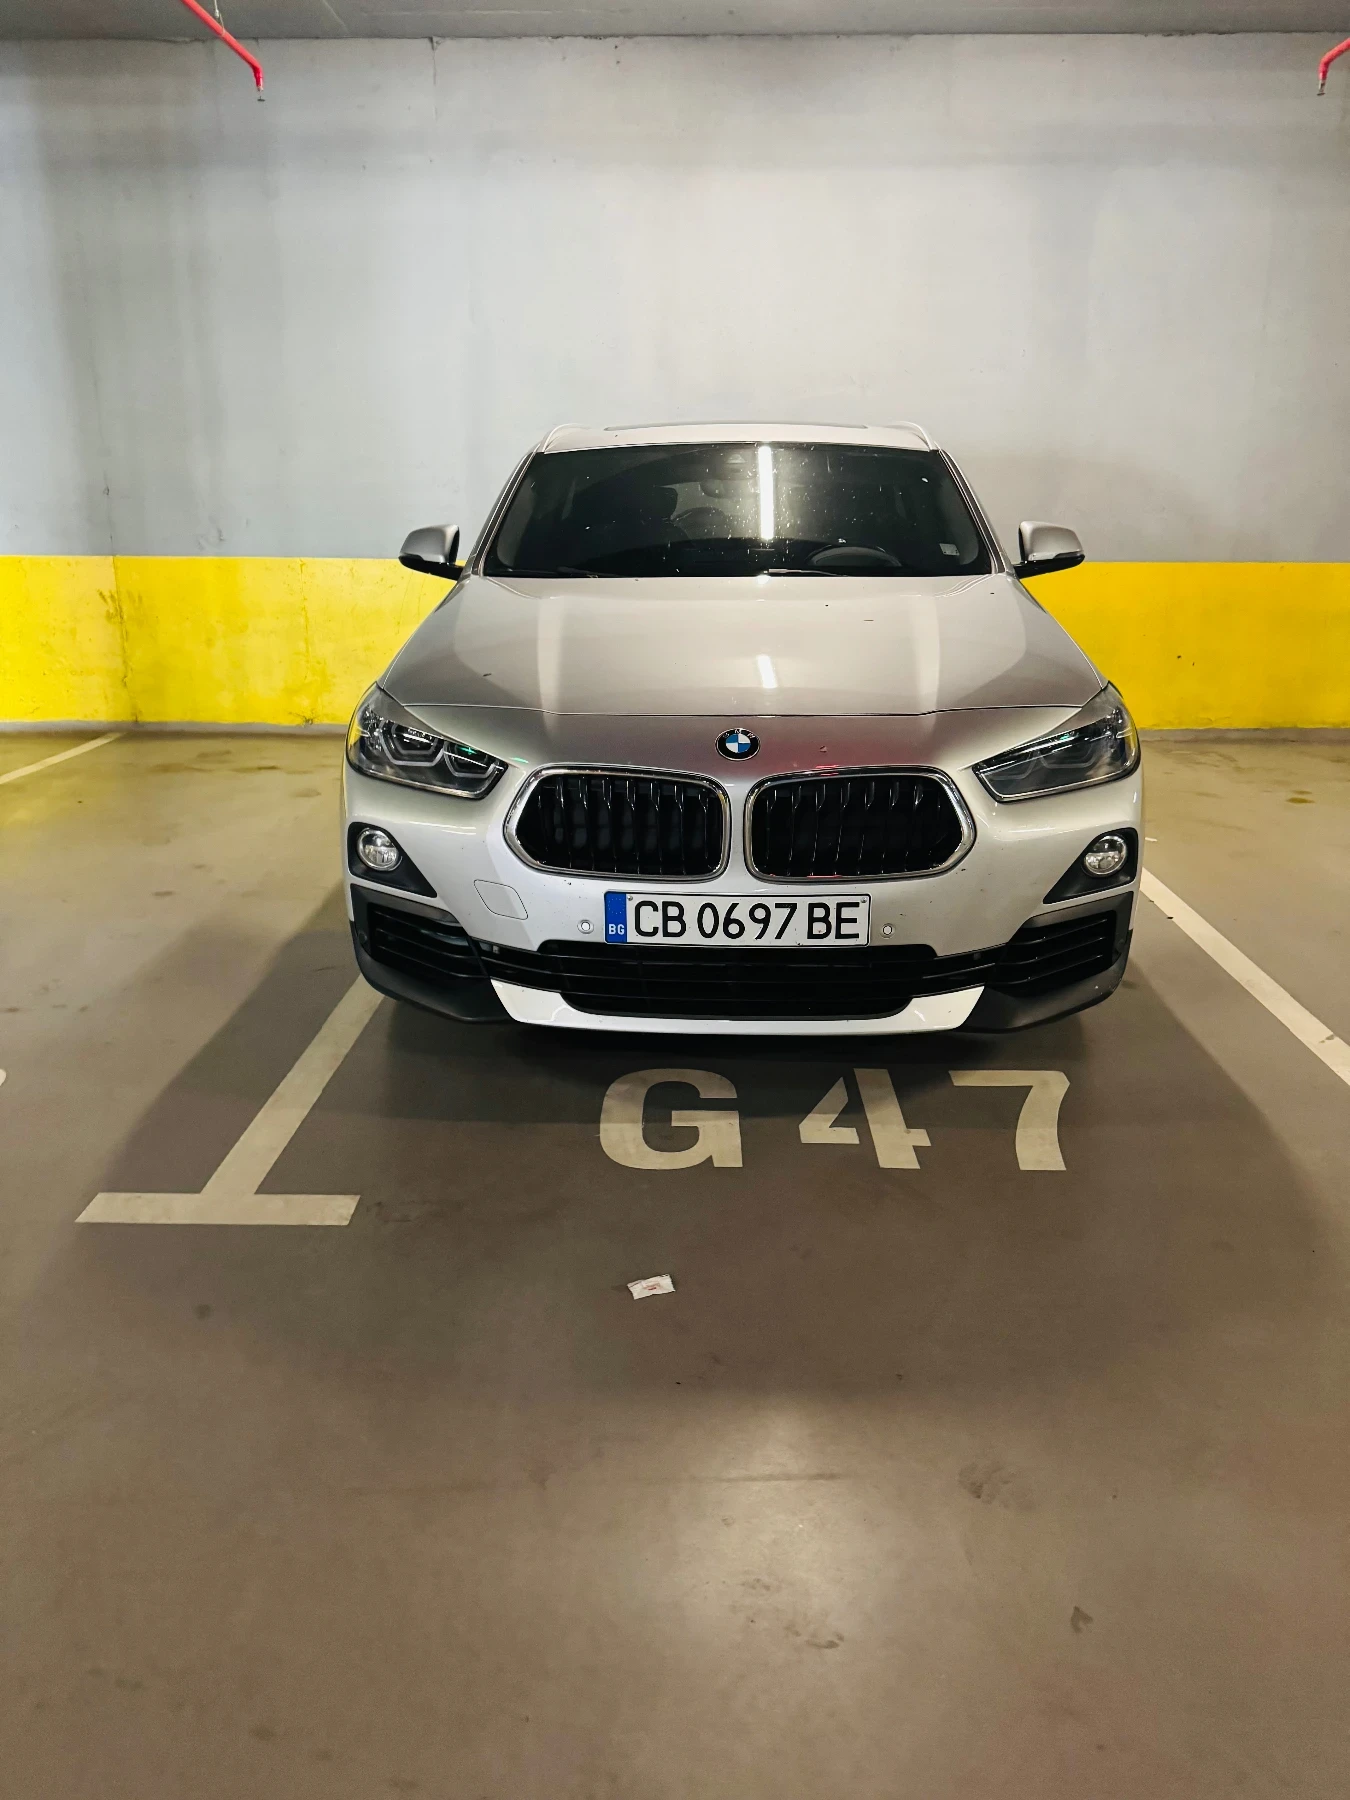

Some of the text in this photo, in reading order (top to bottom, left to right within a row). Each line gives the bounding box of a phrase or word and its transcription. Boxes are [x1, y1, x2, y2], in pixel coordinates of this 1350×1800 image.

[608, 923, 625, 936] BG
[634, 900, 860, 940] CB 0697 BE
[600, 1068, 1070, 1171] G 47
